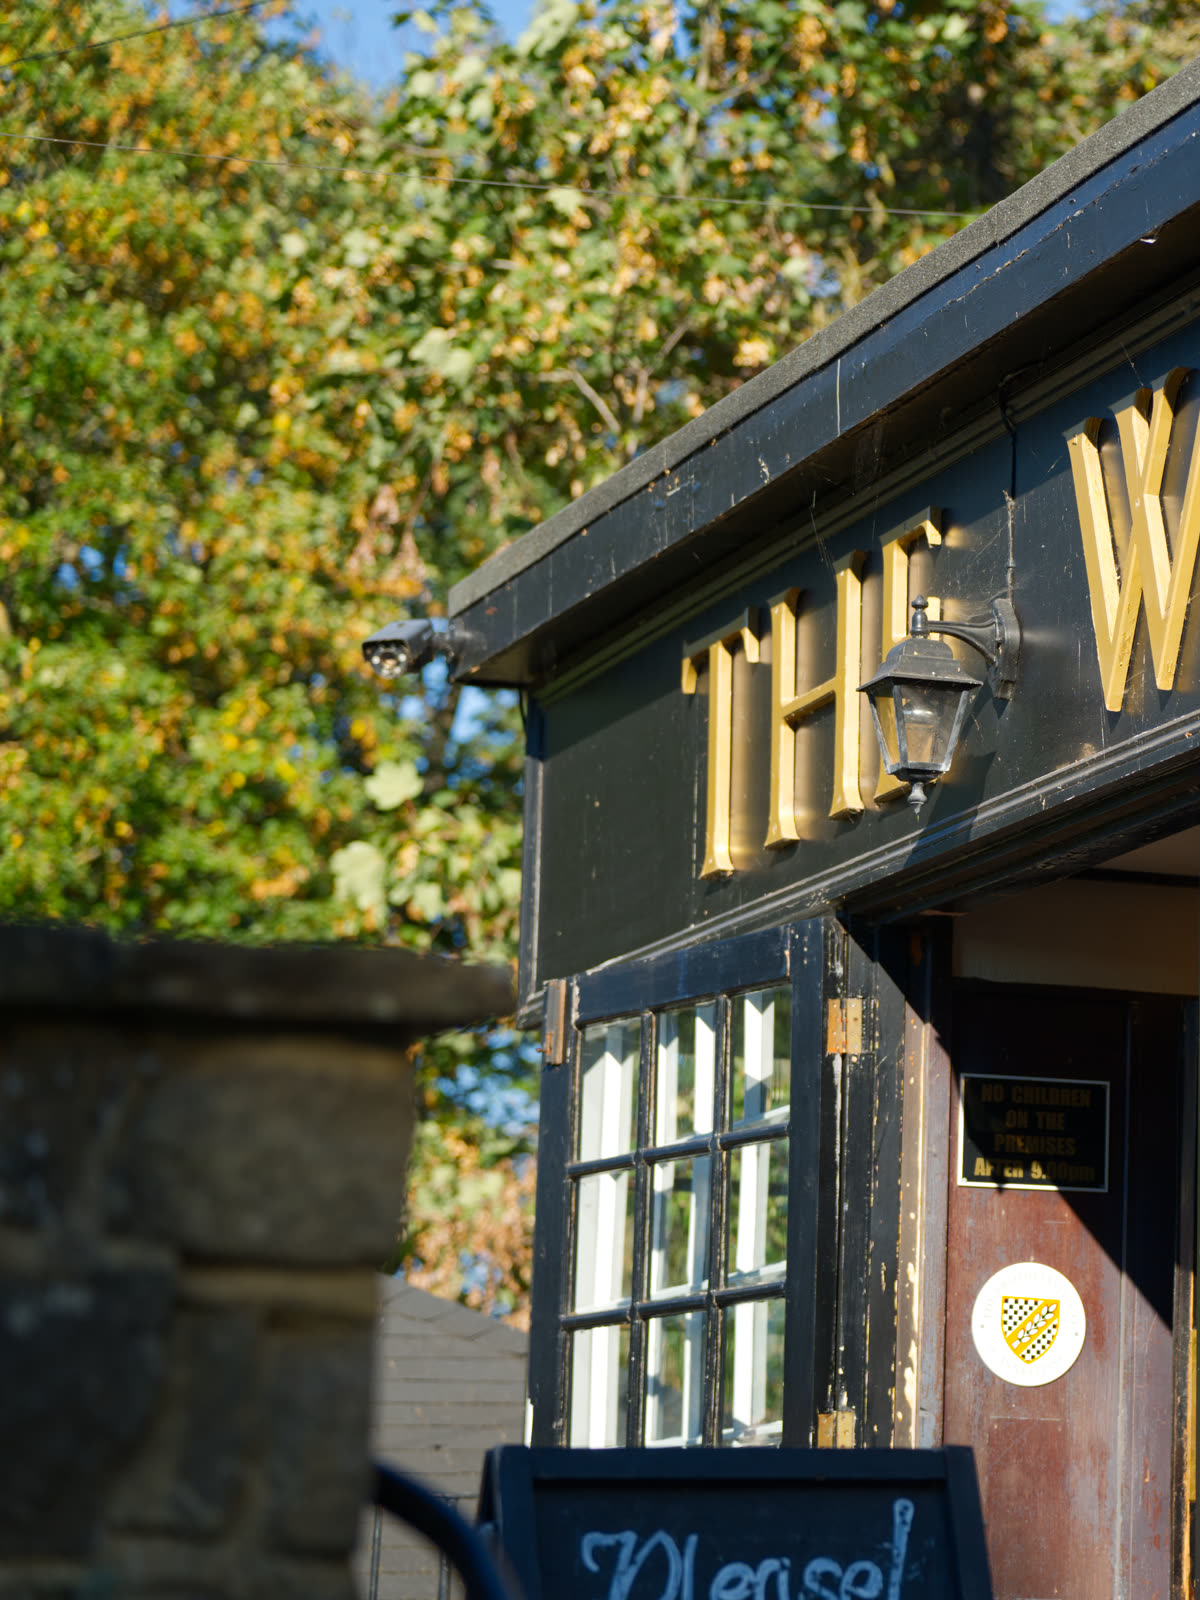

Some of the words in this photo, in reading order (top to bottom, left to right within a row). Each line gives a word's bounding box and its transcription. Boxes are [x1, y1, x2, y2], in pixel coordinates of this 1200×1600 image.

[681, 506, 942, 880] THE
[982, 1083, 1005, 1104] NO
[1011, 1085, 1091, 1108] CHILDREN
[1004, 1110, 1029, 1128] ON
[1036, 1112, 1065, 1131] THE
[994, 1133, 1075, 1154] PREMISES
[974, 1156, 1025, 1179] AFTER
